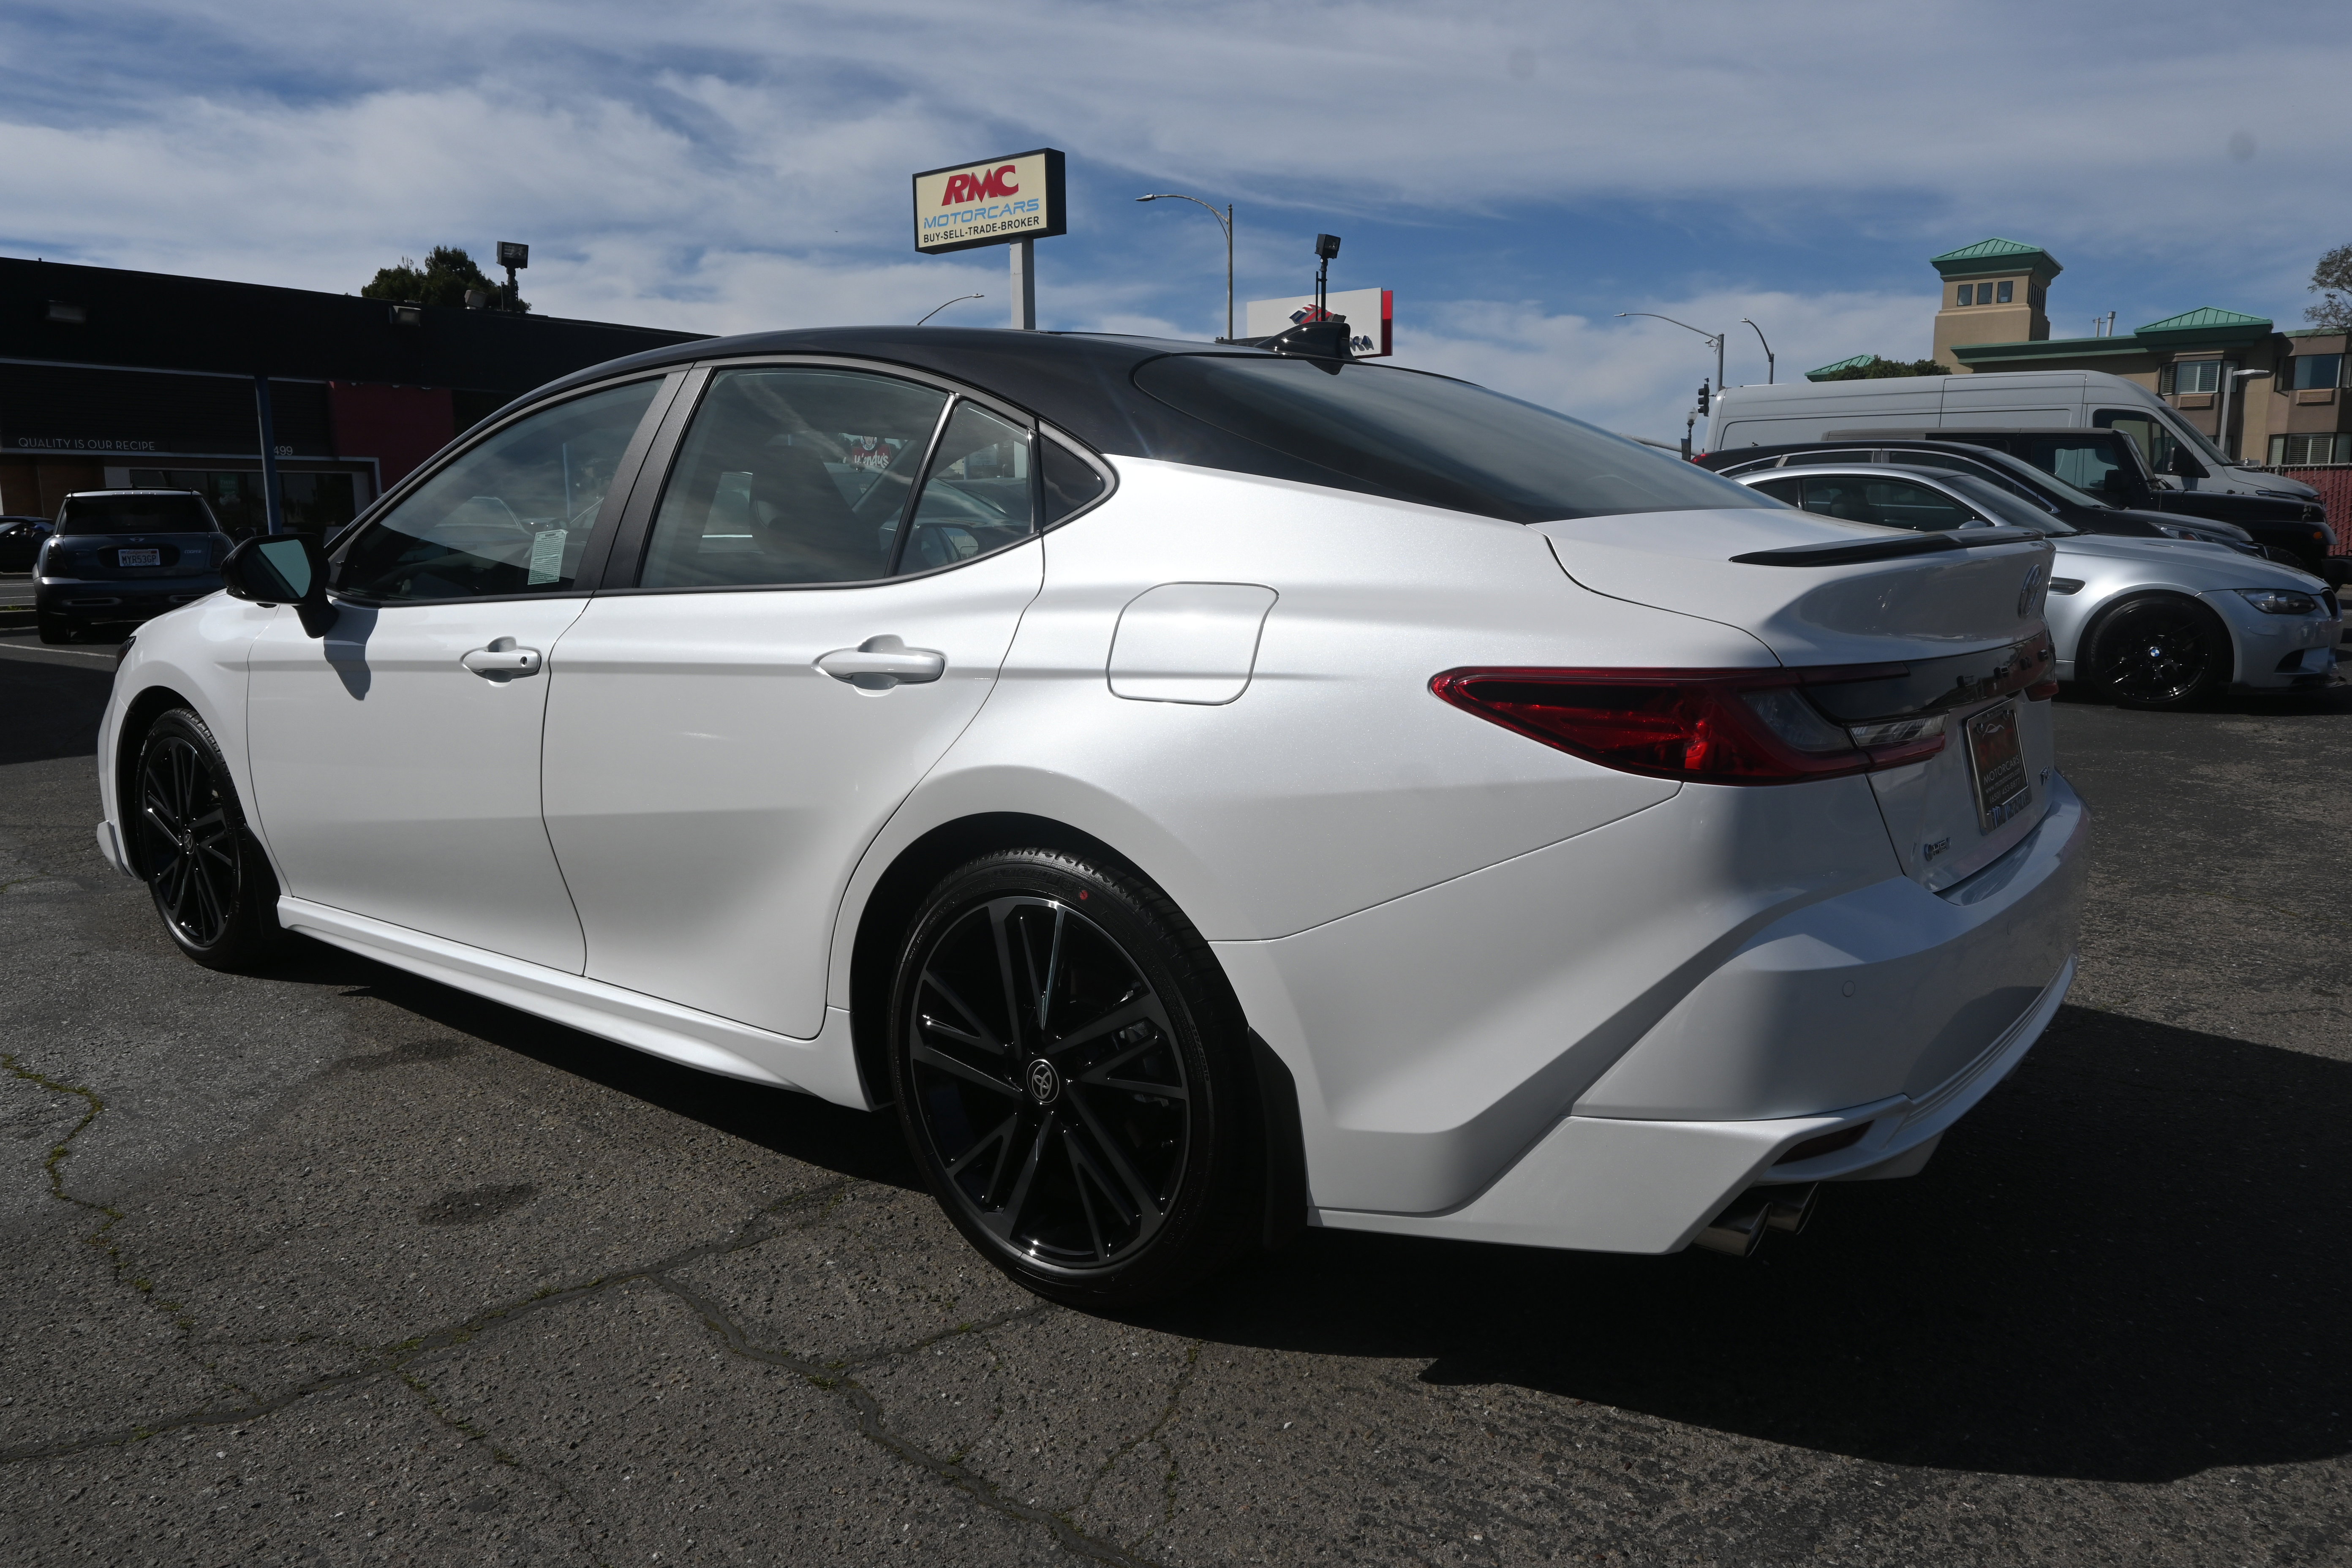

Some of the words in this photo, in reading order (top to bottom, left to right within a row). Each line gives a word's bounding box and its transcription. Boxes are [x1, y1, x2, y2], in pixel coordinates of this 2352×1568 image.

[941, 165, 1019, 206] RMC
[923, 198, 1039, 229] MOTORCARS
[923, 216, 1040, 243] BUY-SELL-TRADE-BROKER
[18, 438, 71, 448] QUALITY
[74, 439, 84, 449] IS
[87, 440, 112, 449] OUR
[116, 440, 155, 450] RECIPE
[122, 555, 156, 564] MYR53GP
[1983, 754, 2020, 785] MOTORCARS
[1989, 790, 2001, 804] (650)
[2002, 778, 2020, 795] 453-8877
